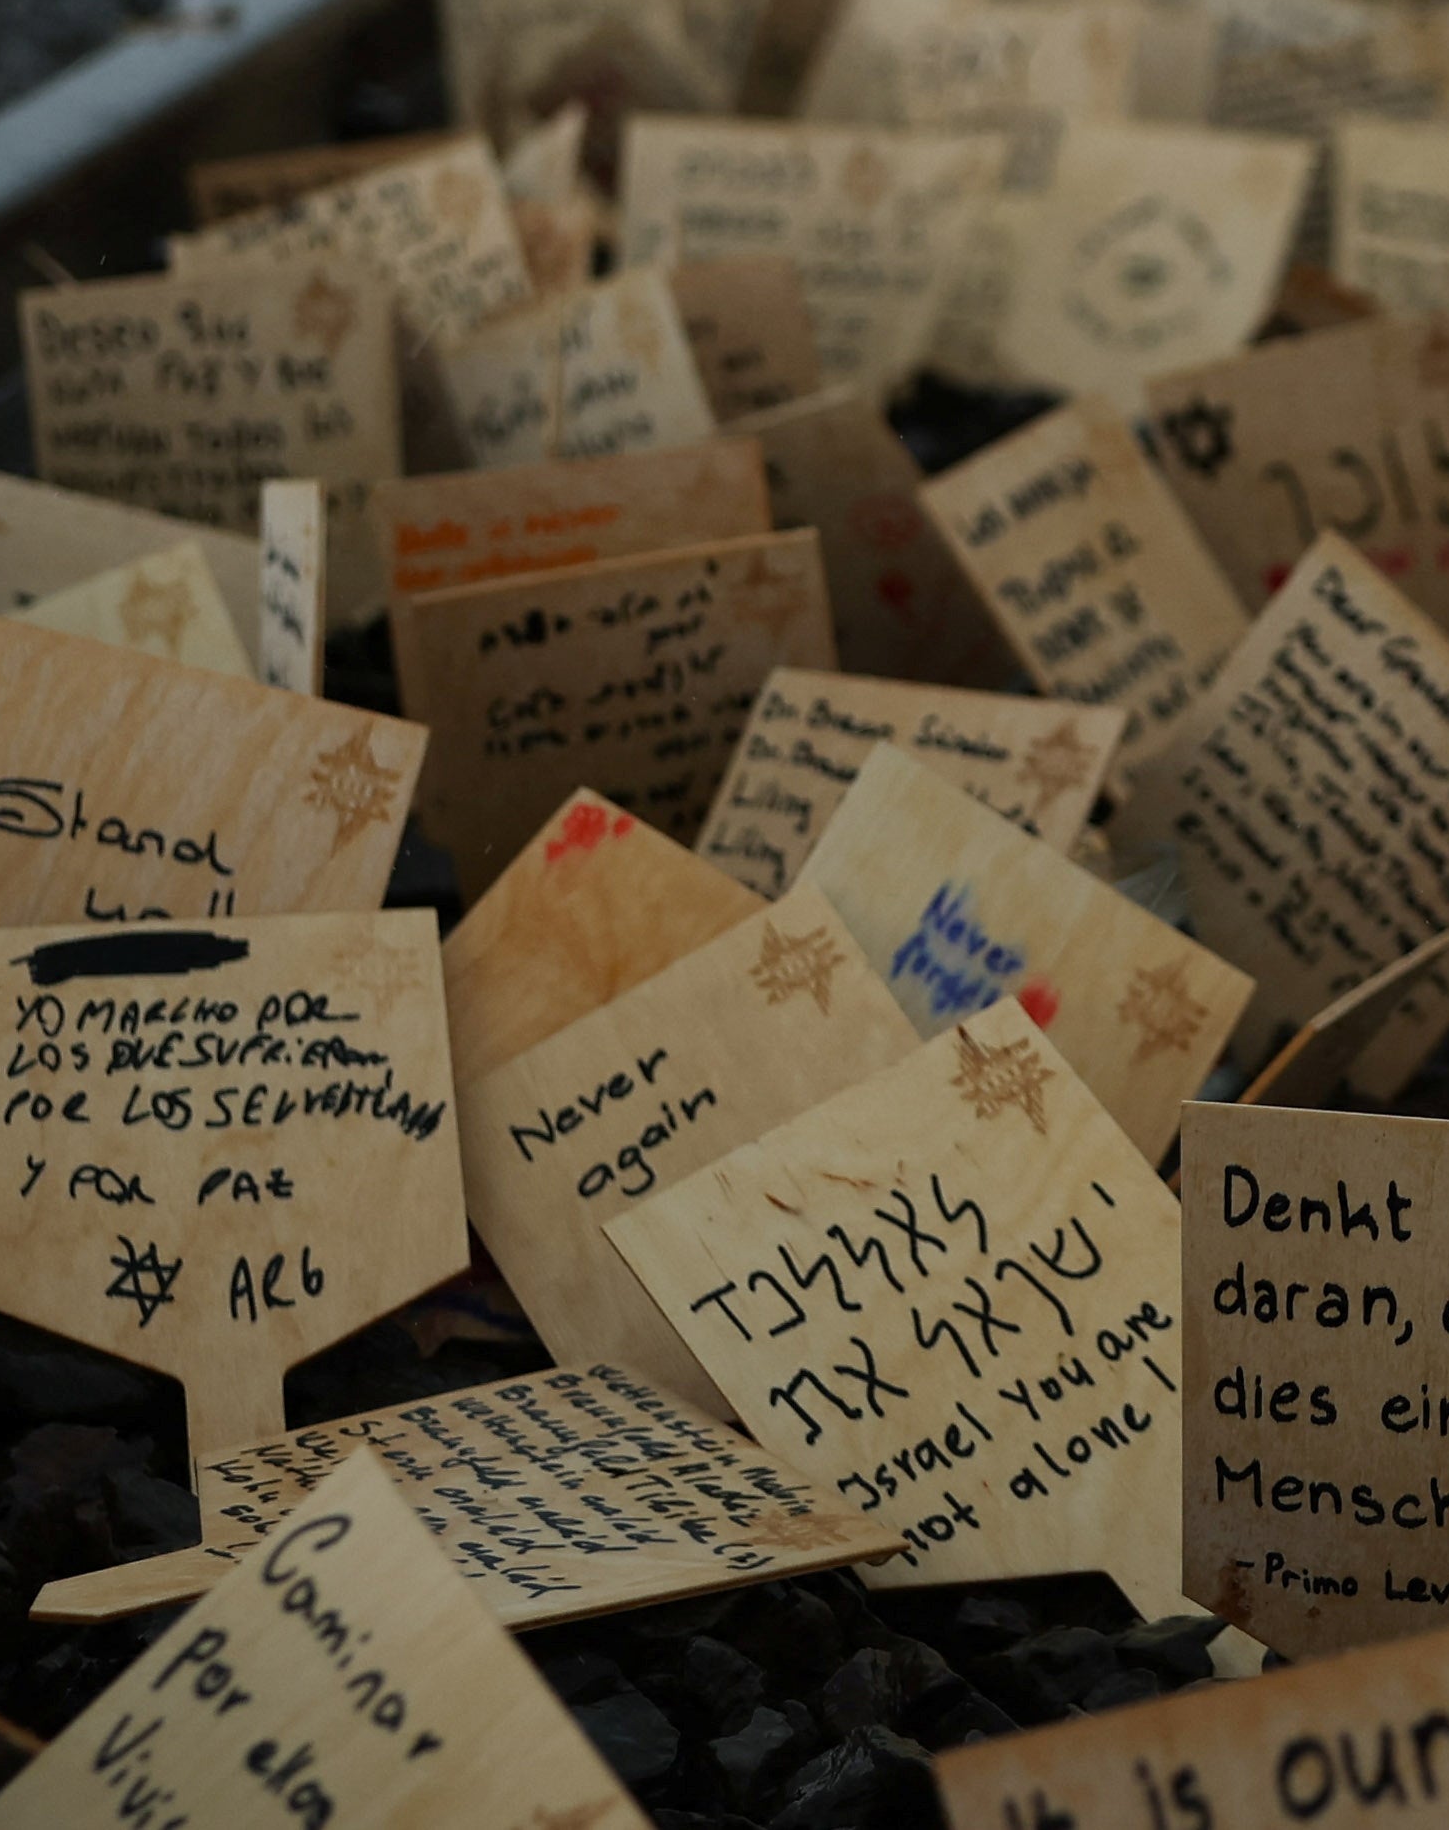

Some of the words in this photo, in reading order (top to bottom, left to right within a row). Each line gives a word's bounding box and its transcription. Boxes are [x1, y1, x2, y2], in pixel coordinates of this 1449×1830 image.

[16, 995, 64, 1037] YO
[508, 1047, 672, 1163] Never
[576, 1088, 718, 1199] again
[68, 1163, 157, 1206] POR
[197, 1167, 294, 1206] PAZ
[1221, 1163, 1416, 1248] Denkt
[1211, 1261, 1416, 1348] daran,
[836, 1400, 994, 1514] Israel
[1095, 1299, 1174, 1363] are
[1212, 1366, 1339, 1428] dies
[261, 1513, 449, 1765] Caminar
